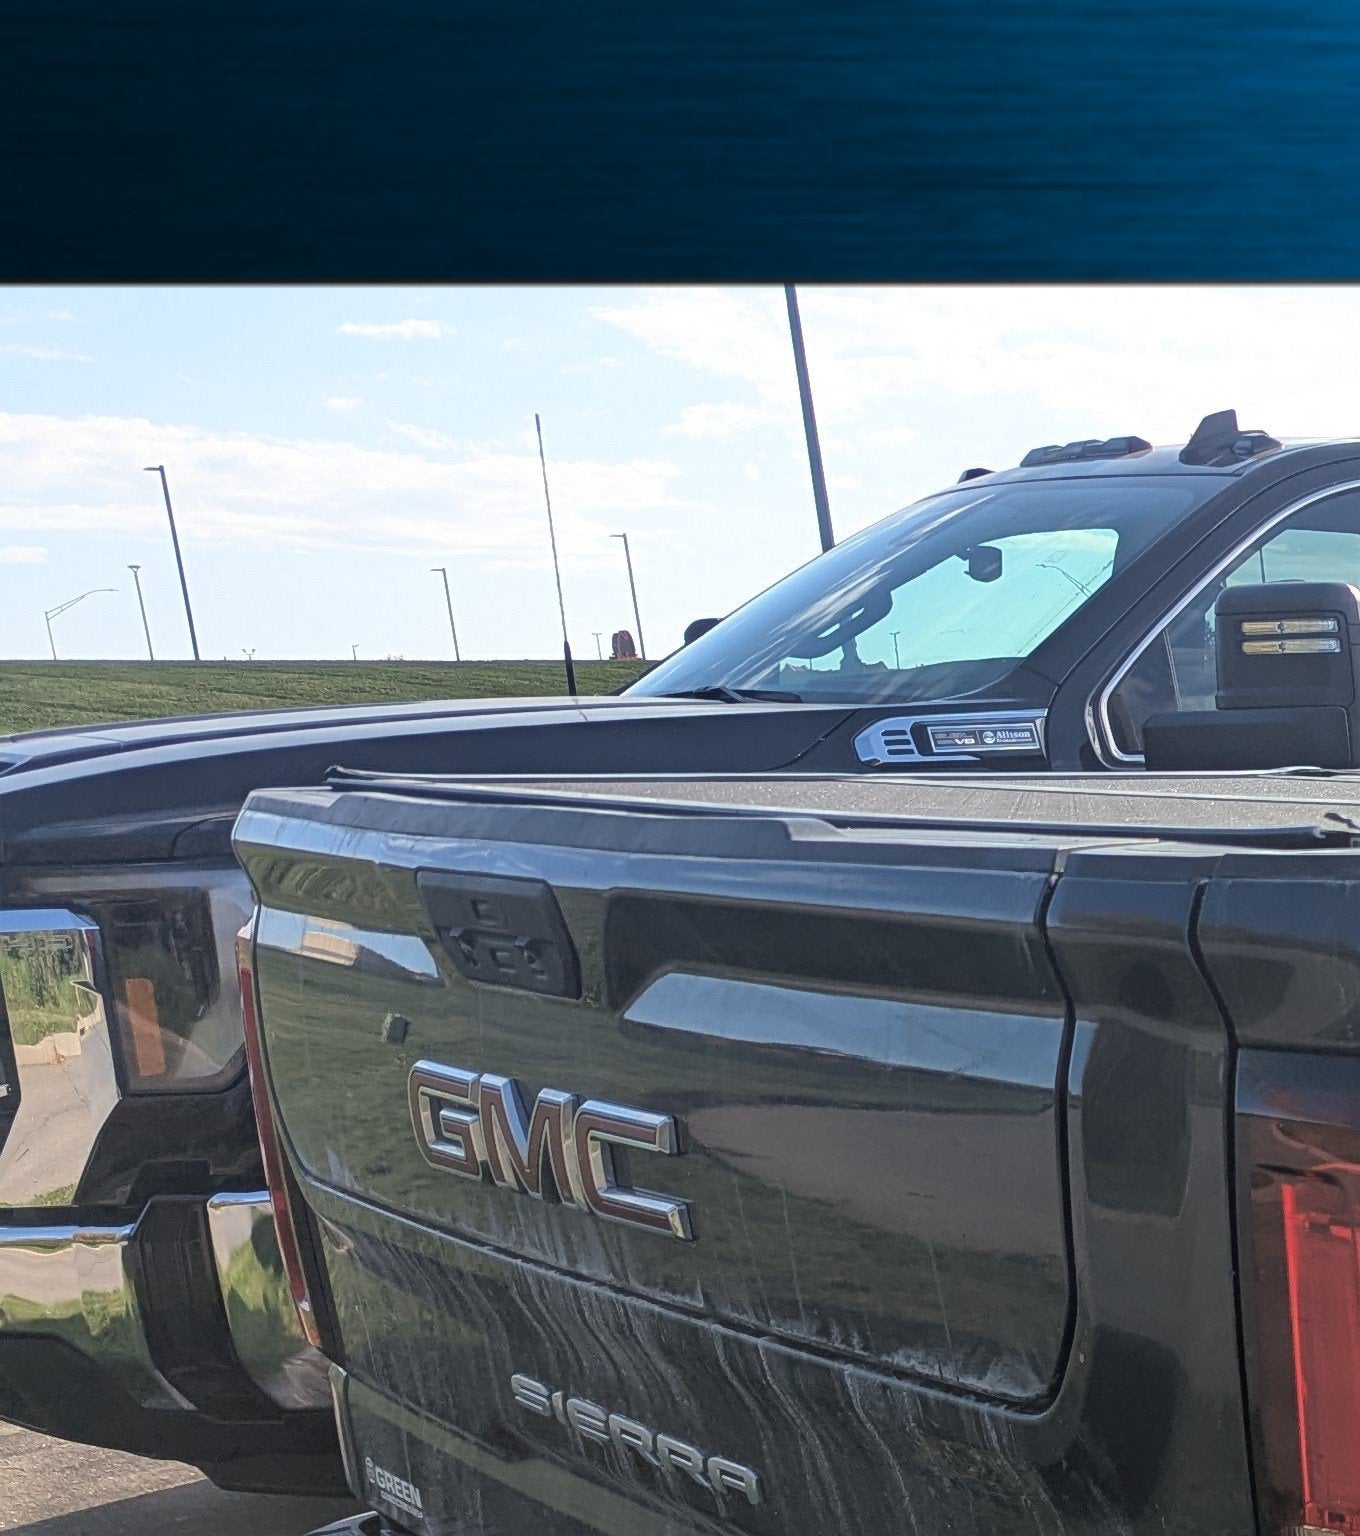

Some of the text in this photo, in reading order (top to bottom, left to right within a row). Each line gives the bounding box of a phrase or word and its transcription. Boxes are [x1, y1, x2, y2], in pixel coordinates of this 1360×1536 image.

[996, 731, 1031, 739] Allison
[408, 1059, 694, 1242] GMC
[510, 1373, 763, 1506] SIERRA
[374, 1464, 423, 1509] GREEN
